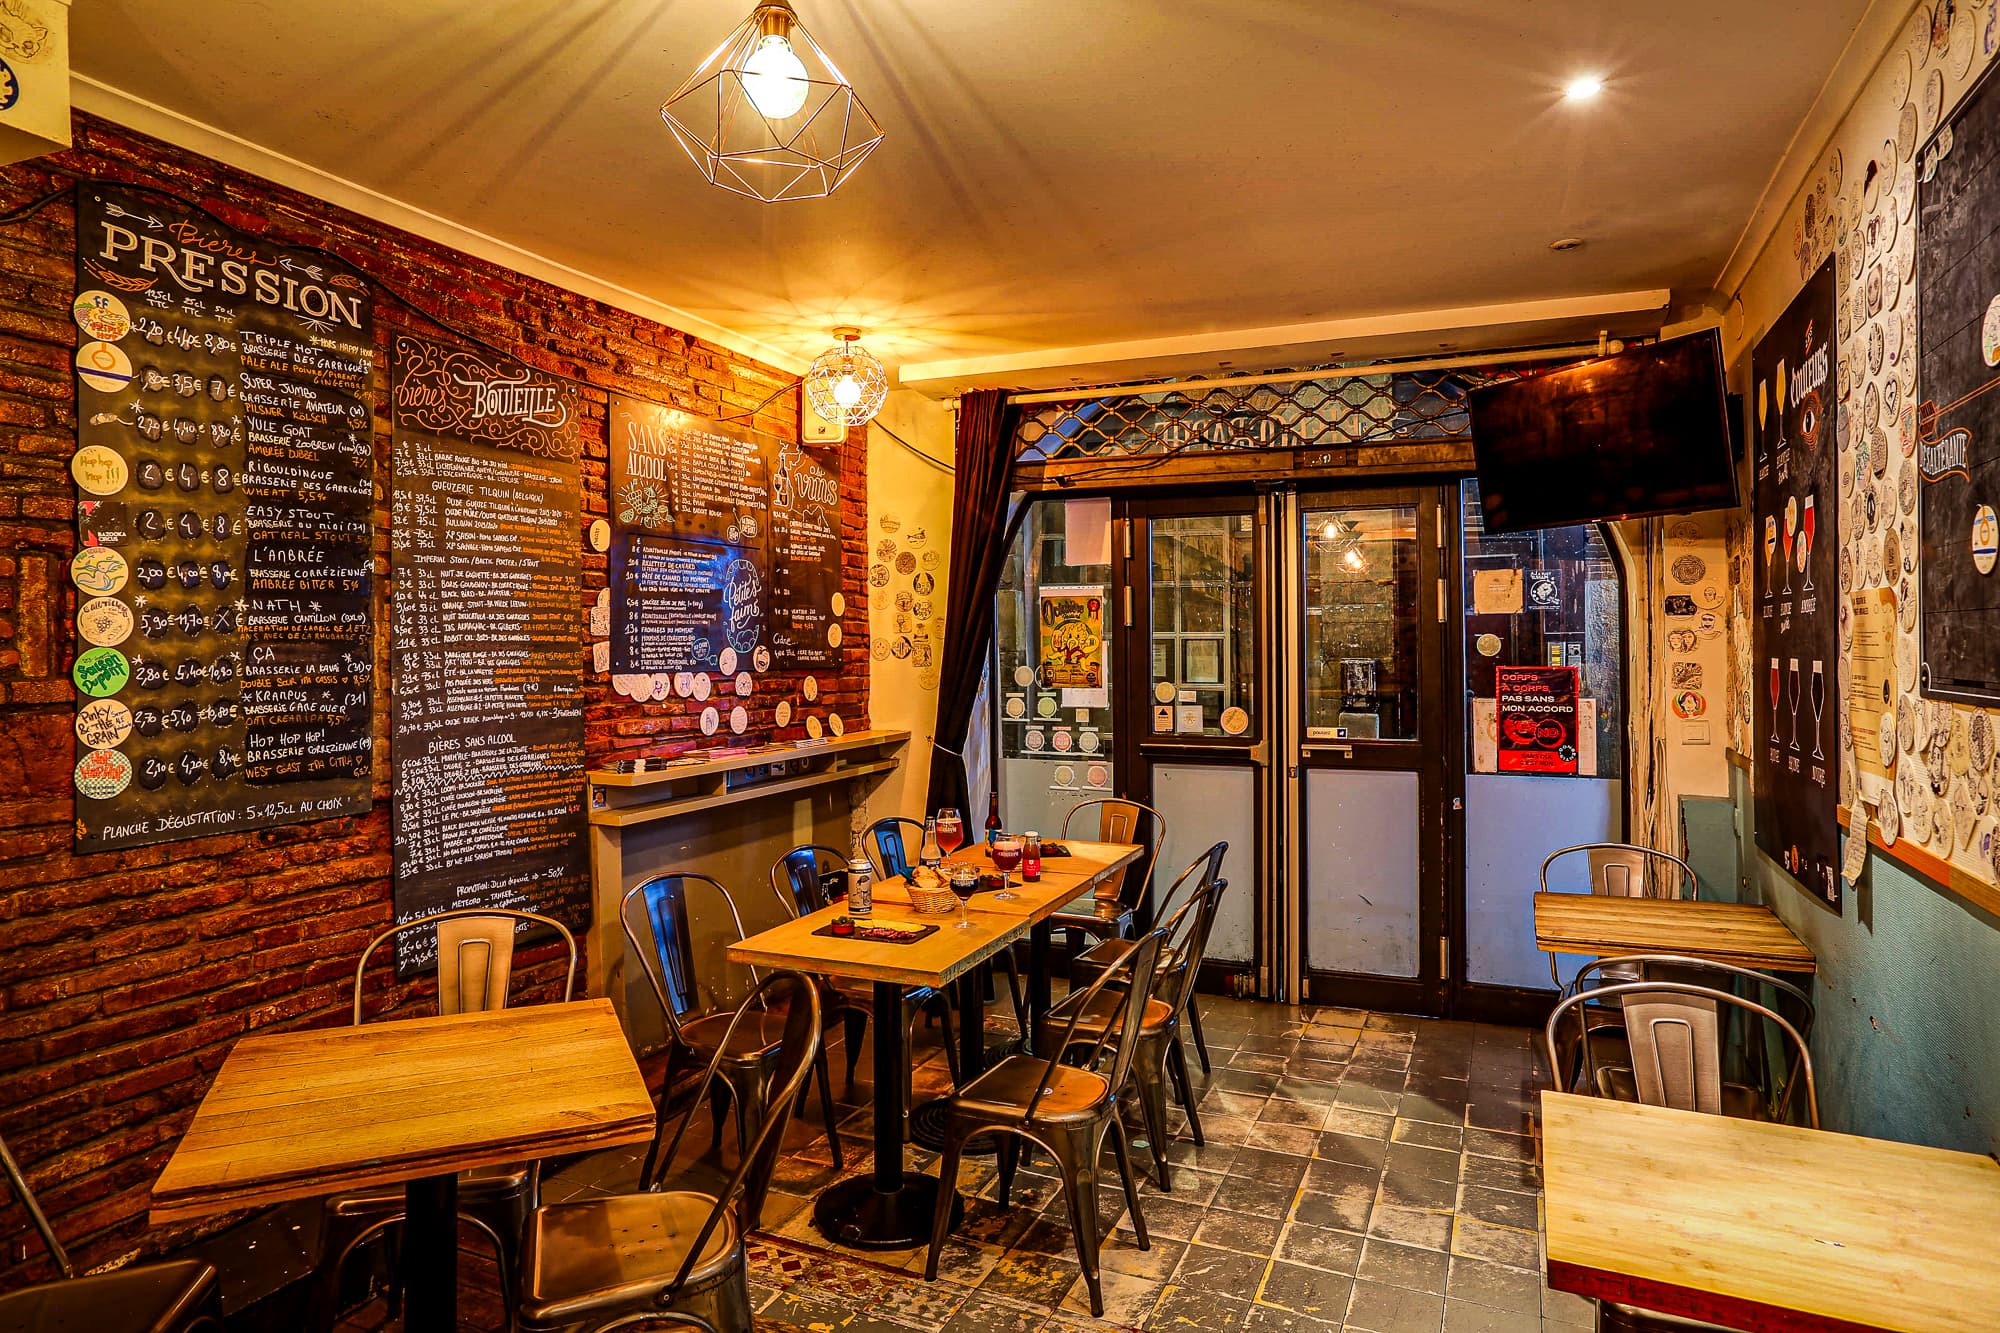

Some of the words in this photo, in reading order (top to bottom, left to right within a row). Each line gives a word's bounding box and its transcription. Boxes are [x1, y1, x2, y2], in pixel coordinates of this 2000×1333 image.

[168, 219, 278, 266] Bières
[100, 221, 362, 329] PRESSION
[146, 298, 169, 309] TTC
[181, 305, 202, 317] TTC
[240, 331, 291, 349] TRIPLE
[295, 343, 323, 356] HOT
[240, 355, 267, 368] PALE
[270, 360, 289, 371] ALE
[241, 342, 287, 359] BRASSERIE
[293, 353, 315, 365] DES
[317, 359, 369, 374] GARRIGUES
[240, 372, 276, 391] SUPER
[278, 383, 317, 400] JUMBO
[240, 392, 301, 409] BRASSERIE
[305, 400, 346, 416] AVIATEUR
[454, 369, 566, 427] BOUTEILLE
[244, 402, 285, 418] PILSNER
[247, 415, 278, 433] YULE
[282, 424, 313, 438] GOAT
[248, 431, 291, 447] BRASSERIE
[627, 420, 667, 457] SANS
[626, 453, 668, 483] ALCOOL
[241, 473, 297, 489] BRASSERIE
[303, 481, 321, 491] DES
[325, 483, 372, 496] GARRIGUES
[241, 487, 291, 497] WHEAT
[479, 486, 510, 499] TILQUIN
[246, 505, 283, 520] EASY
[288, 508, 336, 520] STOUT
[246, 518, 294, 529] BRASSERIE
[252, 530, 280, 541] OAT
[248, 568, 291, 580] BRASSERIE
[251, 599, 301, 613] NATH
[248, 614, 289, 626] BRASSERIE
[293, 612, 337, 624] CANTILLON
[253, 646, 276, 664] ÇA
[245, 664, 301, 676] BRASSERIE
[1502, 674, 1538, 682] CORPS
[240, 678, 272, 690] DOUBLE
[315, 674, 338, 685] CASSIS
[1502, 695, 1524, 703] PAS
[1524, 695, 1555, 703] SANS
[243, 703, 288, 716] BRASSERIE
[319, 704, 347, 715] OVER
[1502, 705, 1526, 713] MON
[1527, 705, 1574, 713] ACCORD
[86, 727, 120, 747] GRAIN
[249, 733, 275, 748] HOP
[279, 732, 302, 747] HOP
[1536, 727, 1560, 738] NO
[465, 736, 486, 749] SANS
[487, 733, 518, 745] ALCOOL
[247, 746, 306, 763] BRASSERIE
[102, 821, 150, 841] PLANCHE
[300, 800, 313, 812] AU
[317, 797, 343, 810] CHOIX
